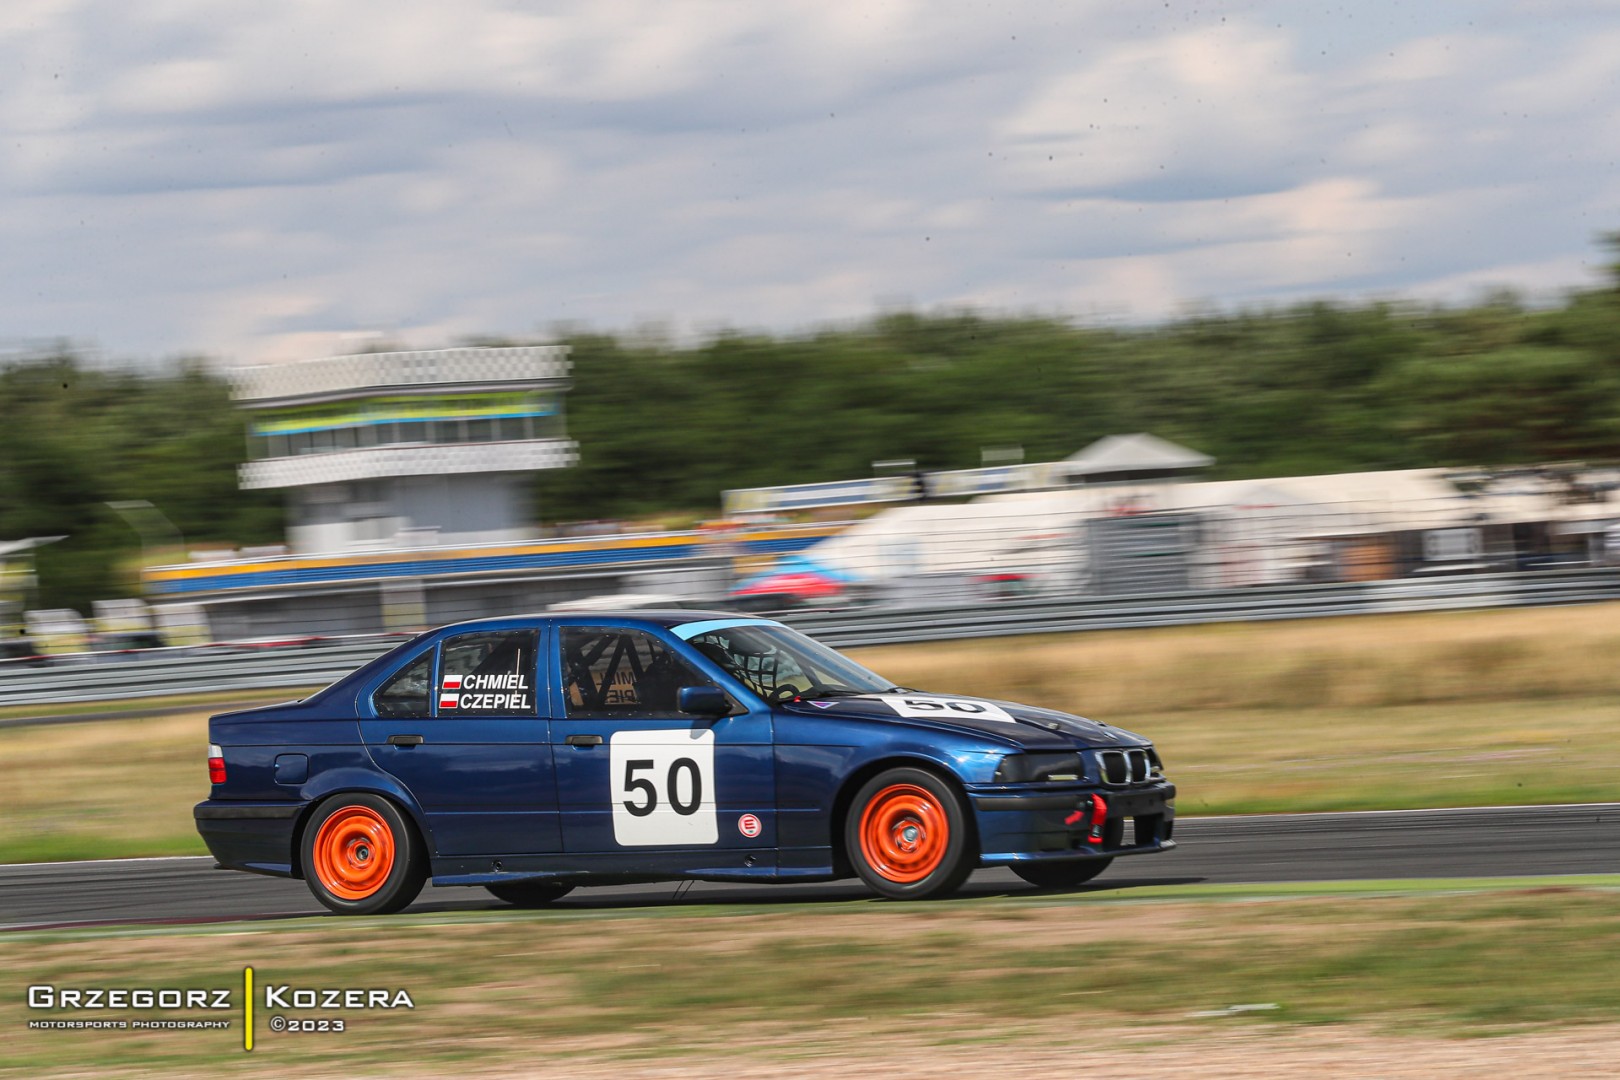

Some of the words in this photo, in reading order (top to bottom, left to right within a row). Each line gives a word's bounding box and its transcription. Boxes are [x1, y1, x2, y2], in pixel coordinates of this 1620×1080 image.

[463, 674, 529, 690] CHMIEL
[460, 693, 531, 709] CZEPIEL
[904, 700, 987, 714] 50
[623, 757, 702, 817] 50
